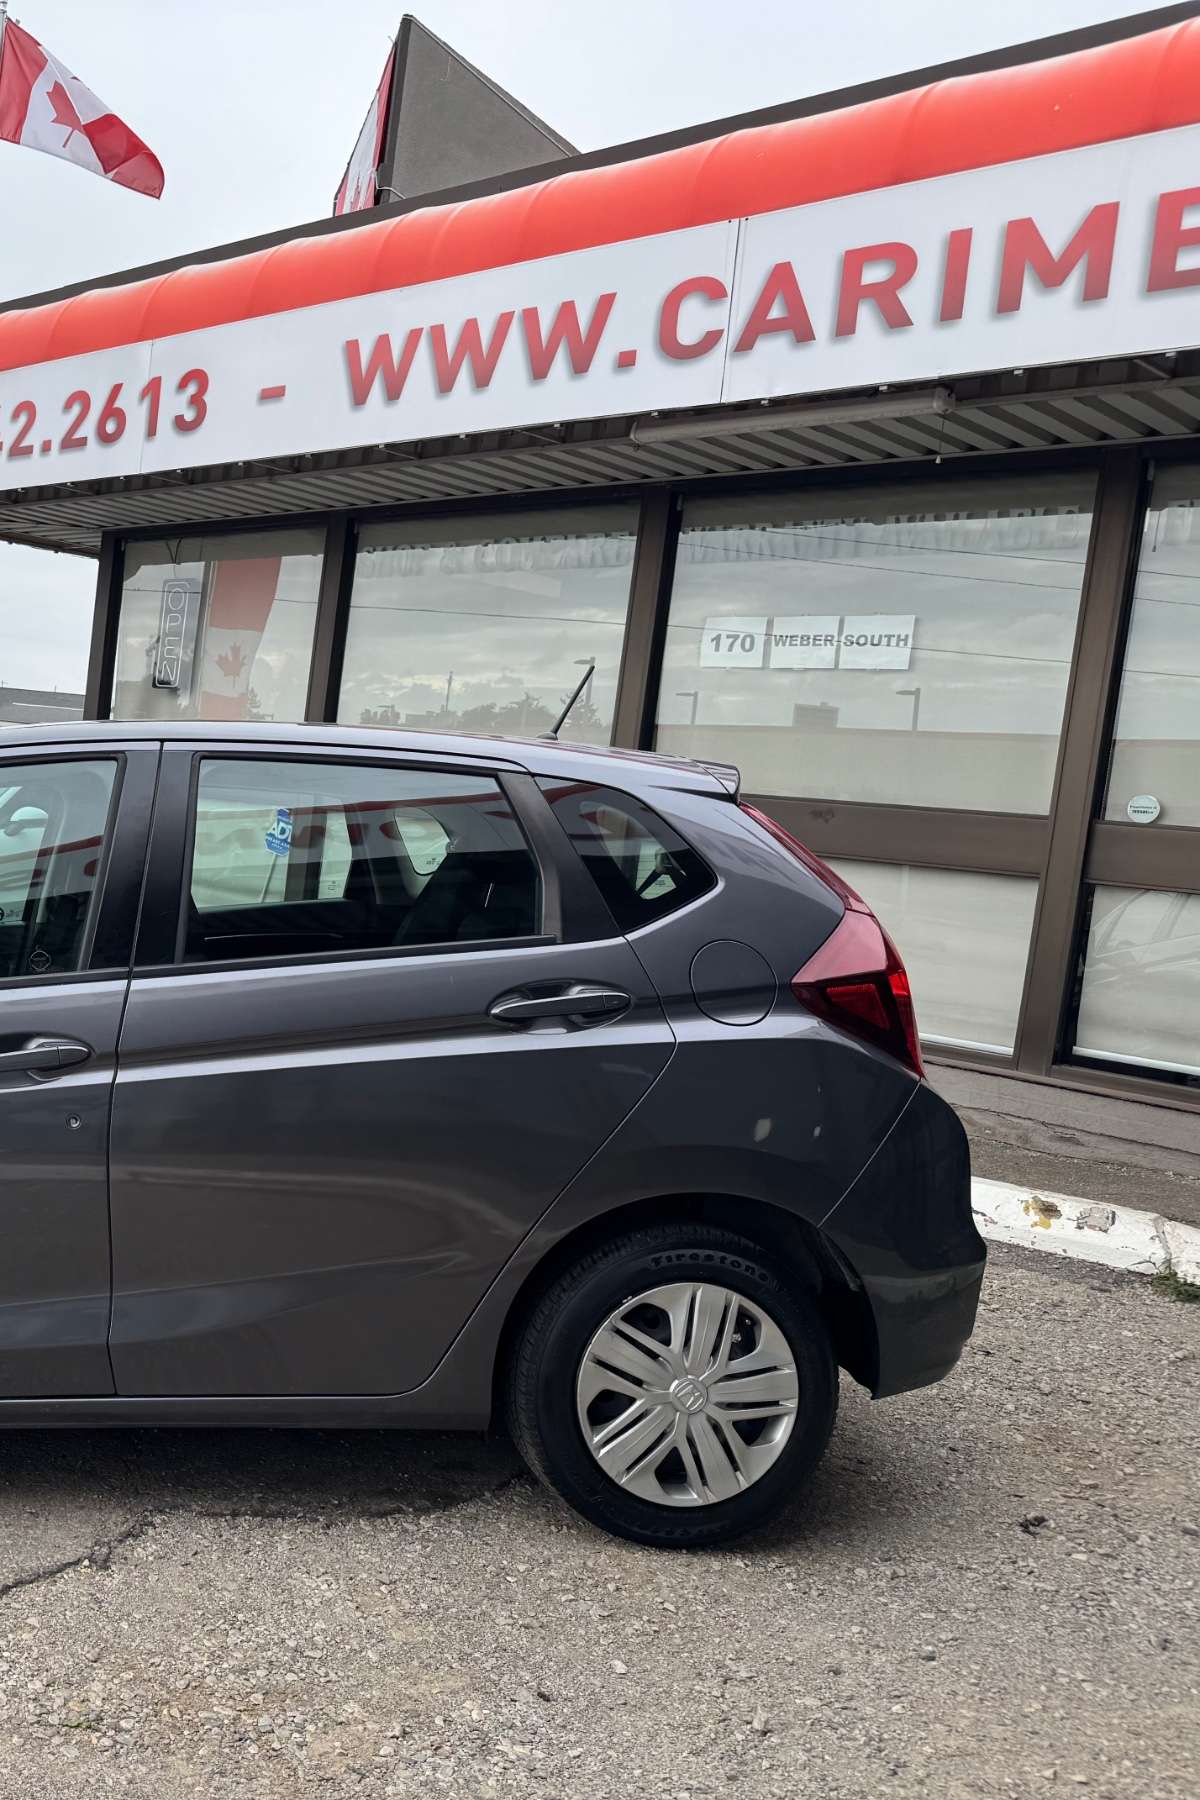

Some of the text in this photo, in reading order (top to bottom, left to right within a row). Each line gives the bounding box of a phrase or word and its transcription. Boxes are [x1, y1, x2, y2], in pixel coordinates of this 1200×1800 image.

[345, 187, 1200, 406] WWW.CARIME
[161, 588, 185, 681] OPEN
[710, 633, 910, 653] 170 WEBER SOUTH
[650, 1252, 769, 1281] Firestone
